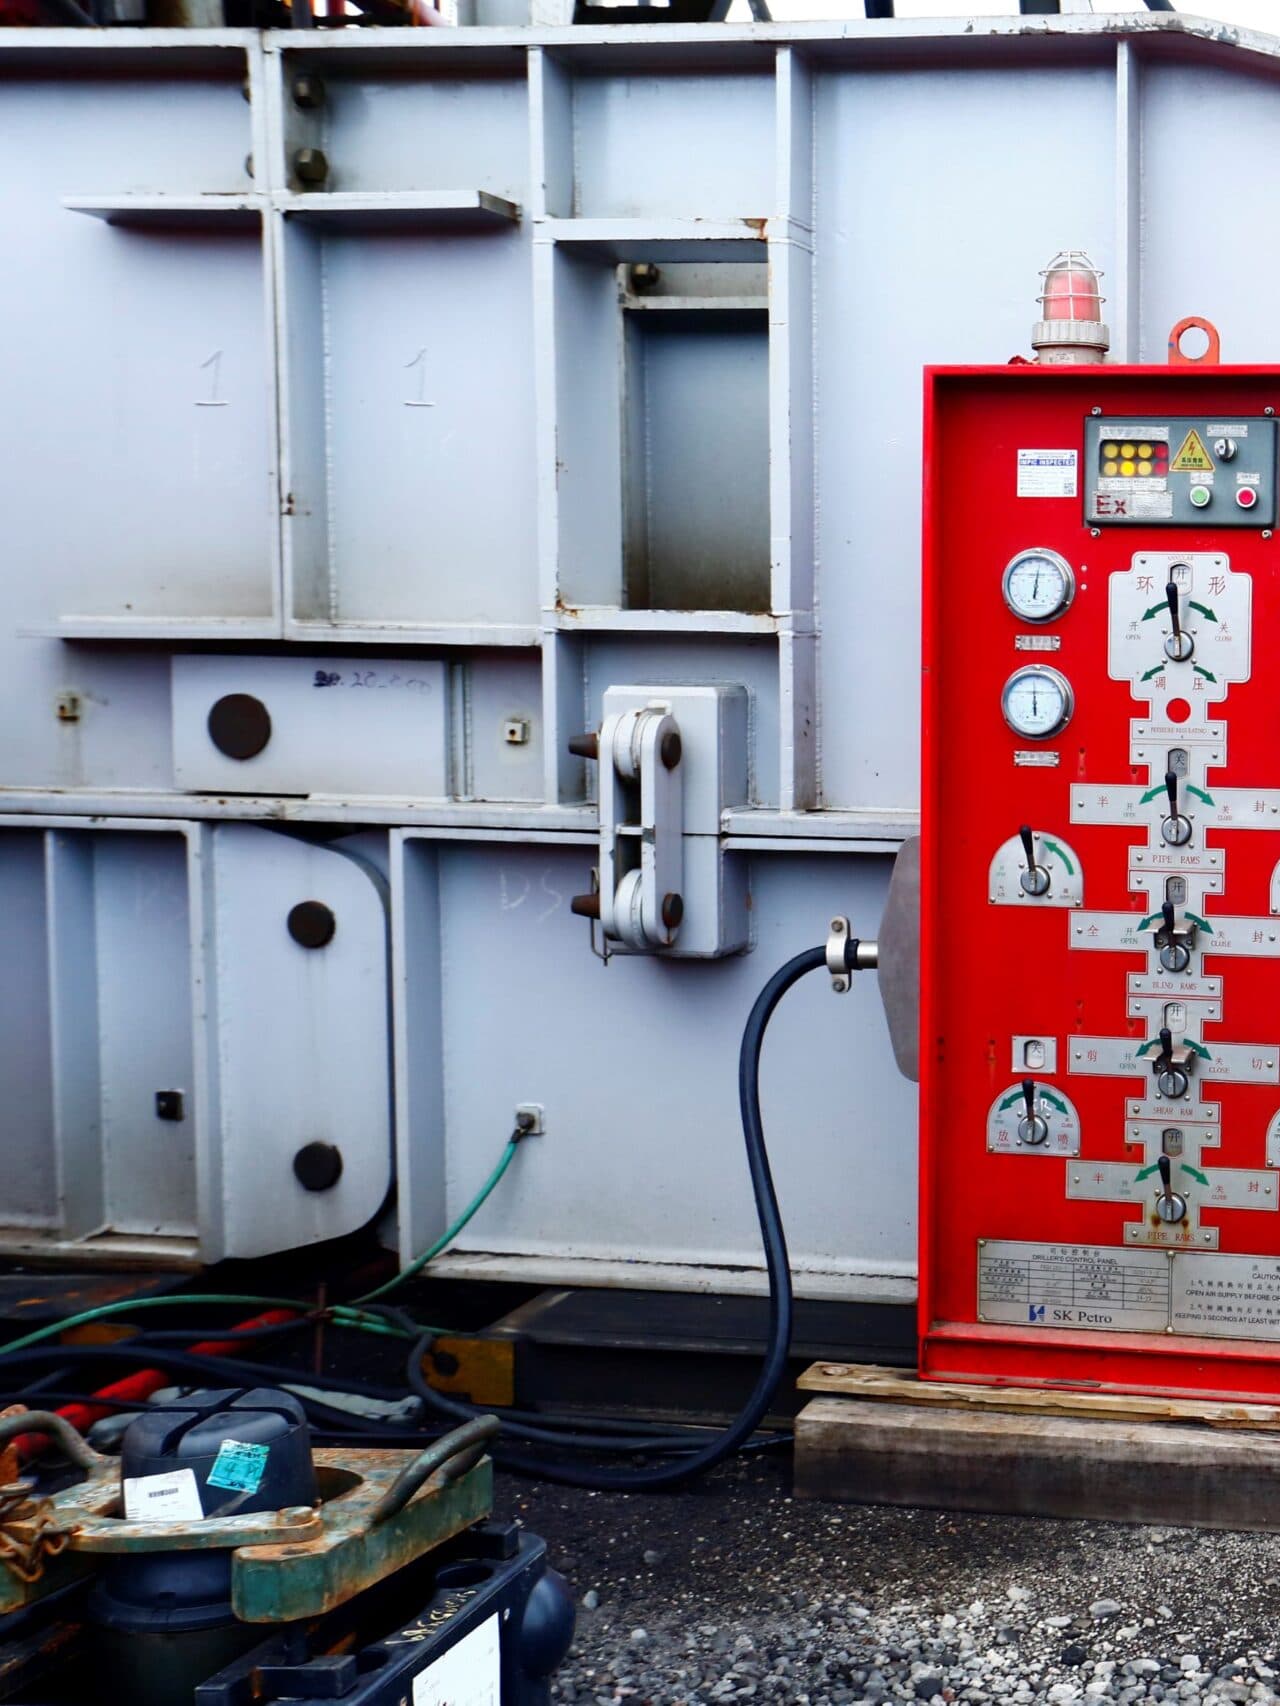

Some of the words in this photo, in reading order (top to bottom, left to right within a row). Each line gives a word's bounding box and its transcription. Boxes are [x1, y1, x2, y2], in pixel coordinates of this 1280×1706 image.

[1096, 495, 1126, 514] Ex
[1136, 575, 1154, 595] 环
[1208, 575, 1226, 596] 形
[1129, 621, 1138, 631] 开
[1219, 622, 1228, 633] 关
[1193, 677, 1204, 691] 压
[1097, 796, 1109, 808] 半
[1152, 854, 1172, 863] PIPE
[1180, 856, 1201, 864] RAMS
[1087, 925, 1099, 937] 全
[1252, 930, 1264, 943] 封
[1211, 940, 1231, 948] CLOSE
[1152, 981, 1173, 989] BLIND
[1180, 982, 1197, 990] RAMS
[1147, 1231, 1168, 1241] PIPE
[1175, 1233, 1195, 1241] RAMS
[1032, 1254, 1065, 1262] DRILLER'S
[1065, 1255, 1097, 1263] CONTROL
[1097, 1257, 1118, 1265] PANEL
[1252, 1273, 1280, 1281] CAUTION
[1217, 1291, 1242, 1299] SUPPLY
[1244, 1293, 1270, 1301] BEFORE
[1053, 1310, 1073, 1322] SK
[1078, 1310, 1112, 1324] Petro
[1207, 1314, 1238, 1323] SECONDS
[1248, 1316, 1268, 1324] LEAST
